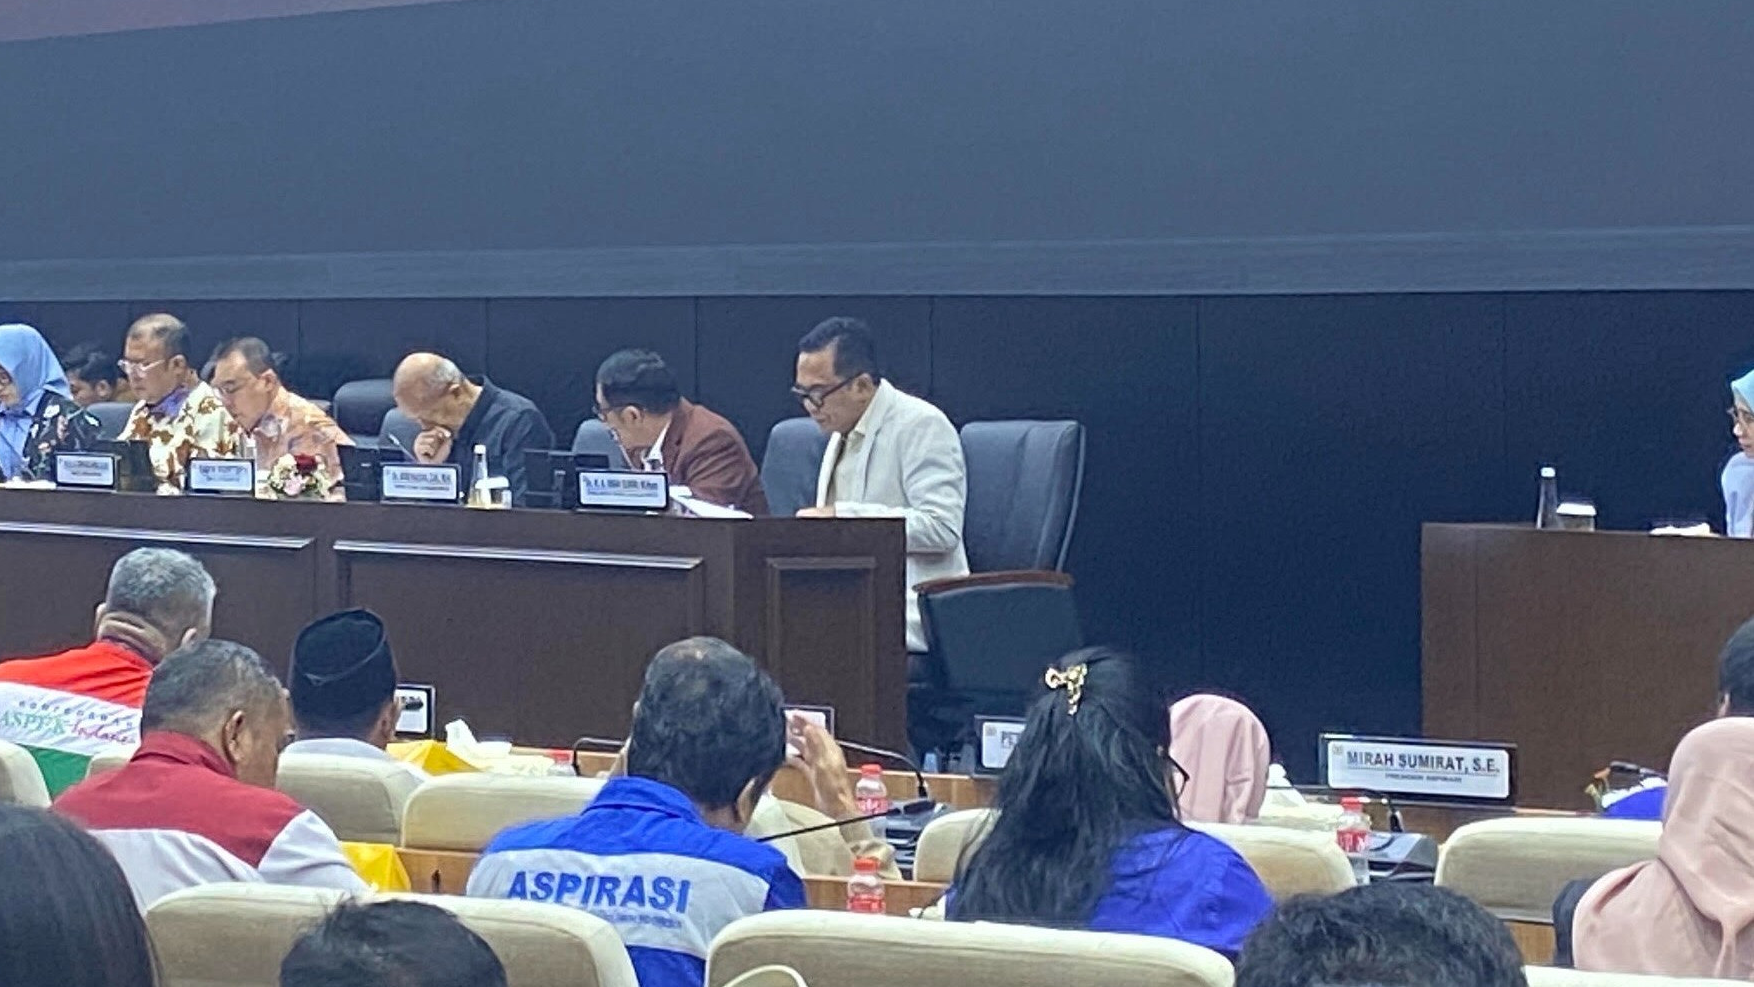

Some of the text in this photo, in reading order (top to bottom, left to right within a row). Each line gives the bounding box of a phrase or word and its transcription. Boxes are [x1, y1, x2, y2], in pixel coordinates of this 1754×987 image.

[1347, 751, 1501, 774] MIRAH SUMIRAT, S.E.
[507, 870, 691, 914] ASPIRASI
